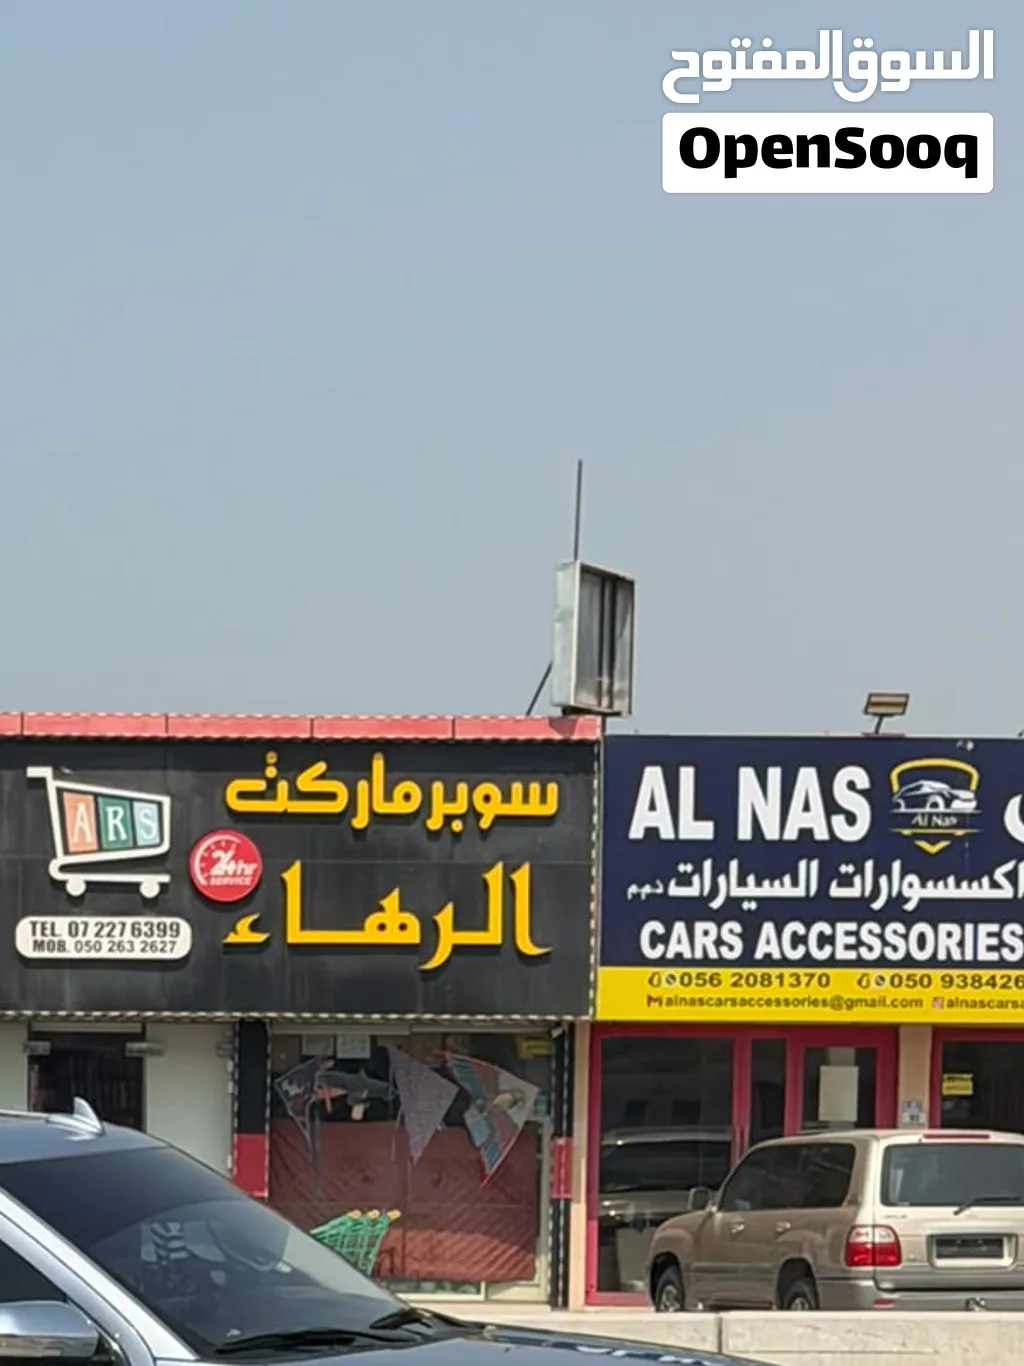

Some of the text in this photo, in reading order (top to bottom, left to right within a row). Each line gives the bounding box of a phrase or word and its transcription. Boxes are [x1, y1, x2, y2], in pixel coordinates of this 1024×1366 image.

[72, 802, 157, 843] ARS
[628, 764, 872, 842] AL NAS
[667, 857, 820, 911] السيارات
[29, 920, 181, 939] TEL. 07 227 6399
[222, 859, 553, 971] الرهاء
[74, 939, 102, 953] 050
[107, 939, 135, 953] 263
[139, 939, 178, 954] 2627
[639, 920, 1024, 963] CARS ACCESSORIES
[679, 971, 831, 989] 056 2081370
[889, 972, 932, 989] 050
